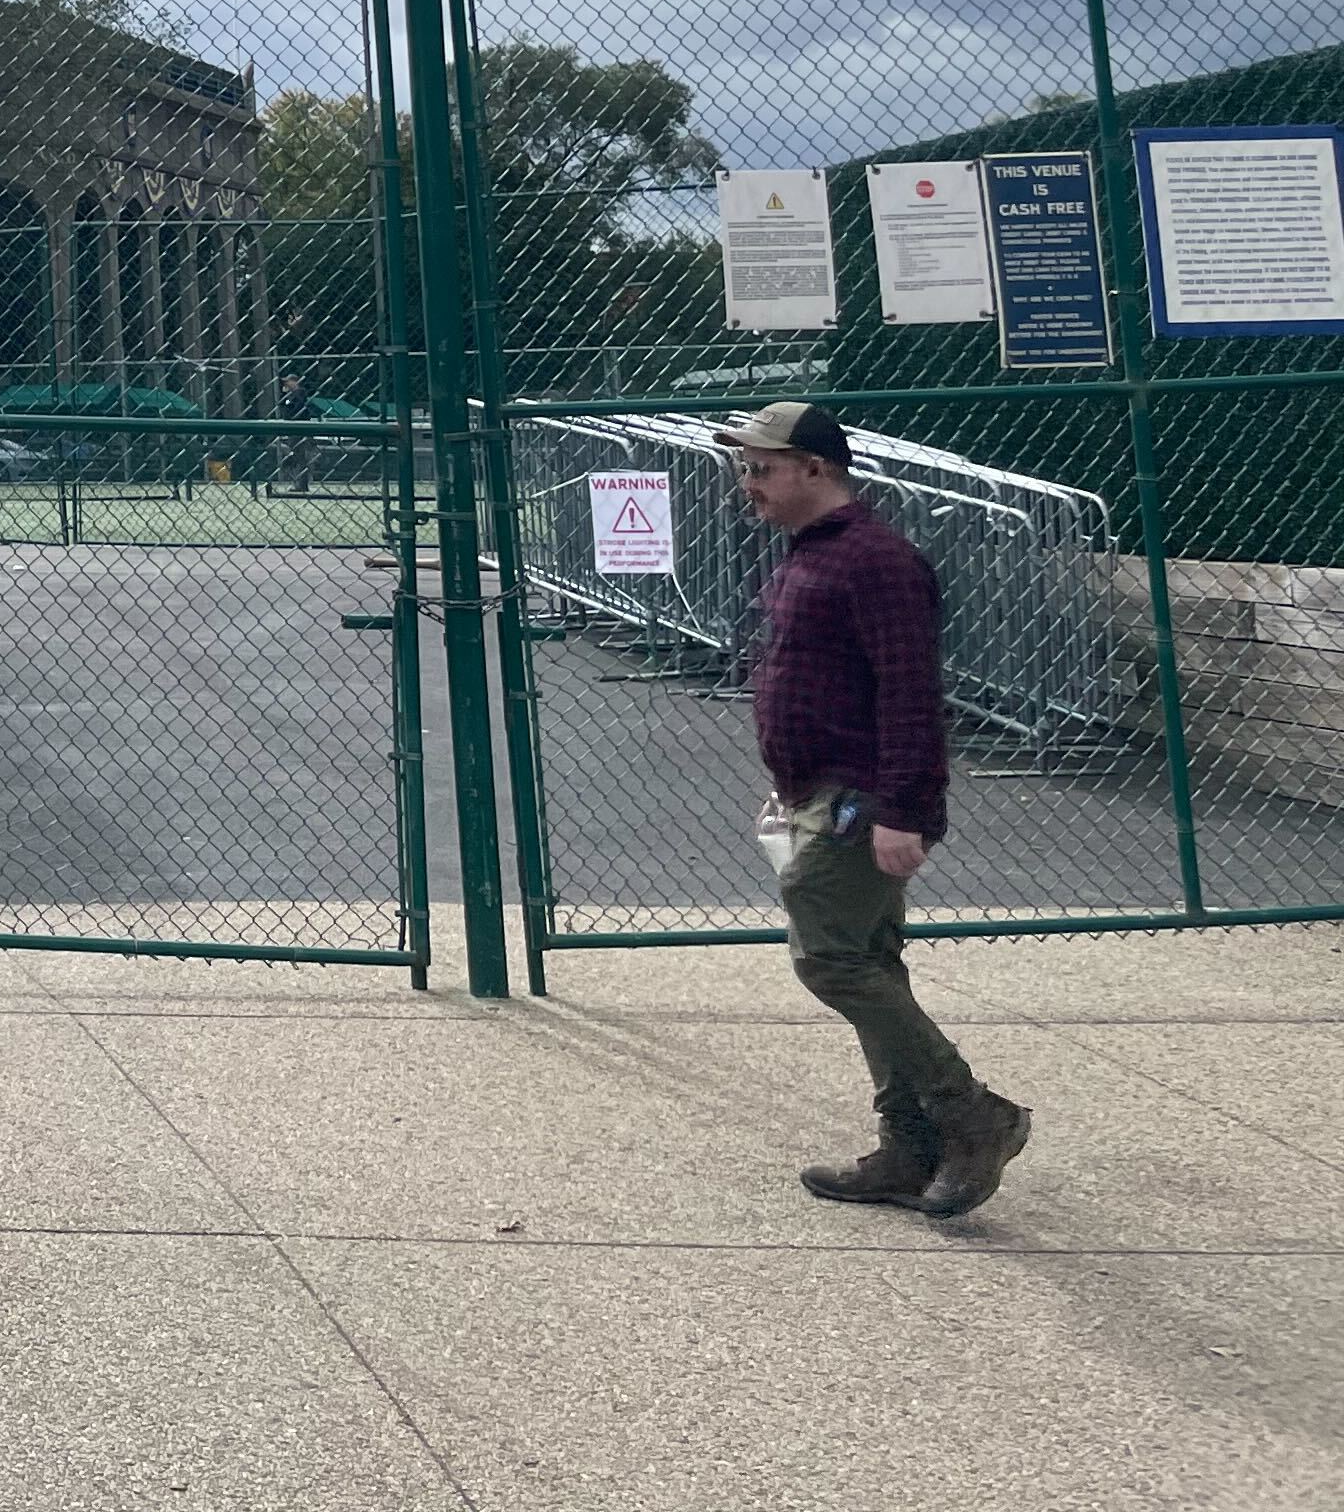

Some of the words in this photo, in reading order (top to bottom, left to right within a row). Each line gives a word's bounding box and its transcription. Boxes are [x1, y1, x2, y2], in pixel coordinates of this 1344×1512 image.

[993, 166, 1027, 178] THIS
[1031, 164, 1082, 177] VENUE
[1033, 184, 1049, 196] IS
[999, 203, 1041, 216] CASH
[1047, 202, 1086, 214] FREE
[591, 478, 667, 490] WARNING
